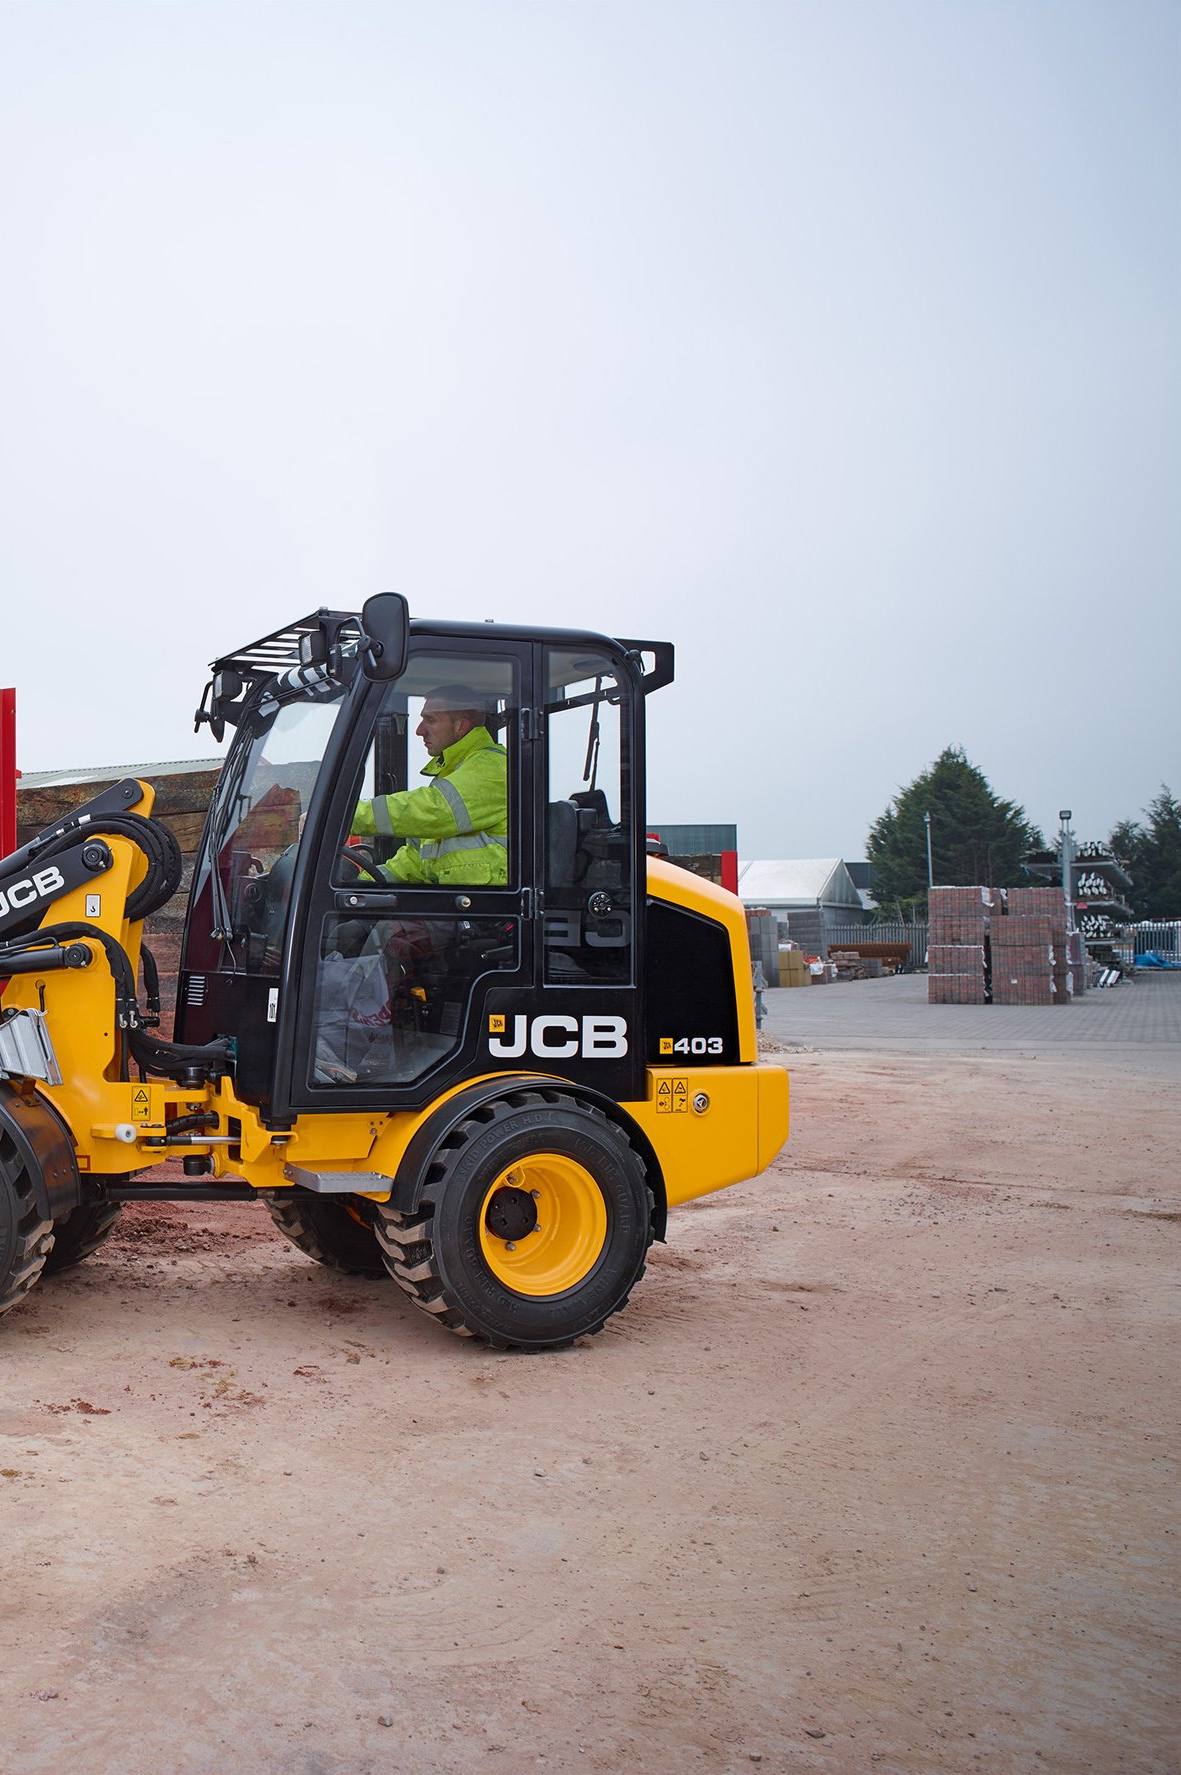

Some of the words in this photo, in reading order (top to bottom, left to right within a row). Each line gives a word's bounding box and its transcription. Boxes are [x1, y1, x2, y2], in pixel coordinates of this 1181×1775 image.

[489, 1015, 628, 1058] JCB
[674, 1037, 723, 1054] 403
[479, 1119, 517, 1149] POWER
